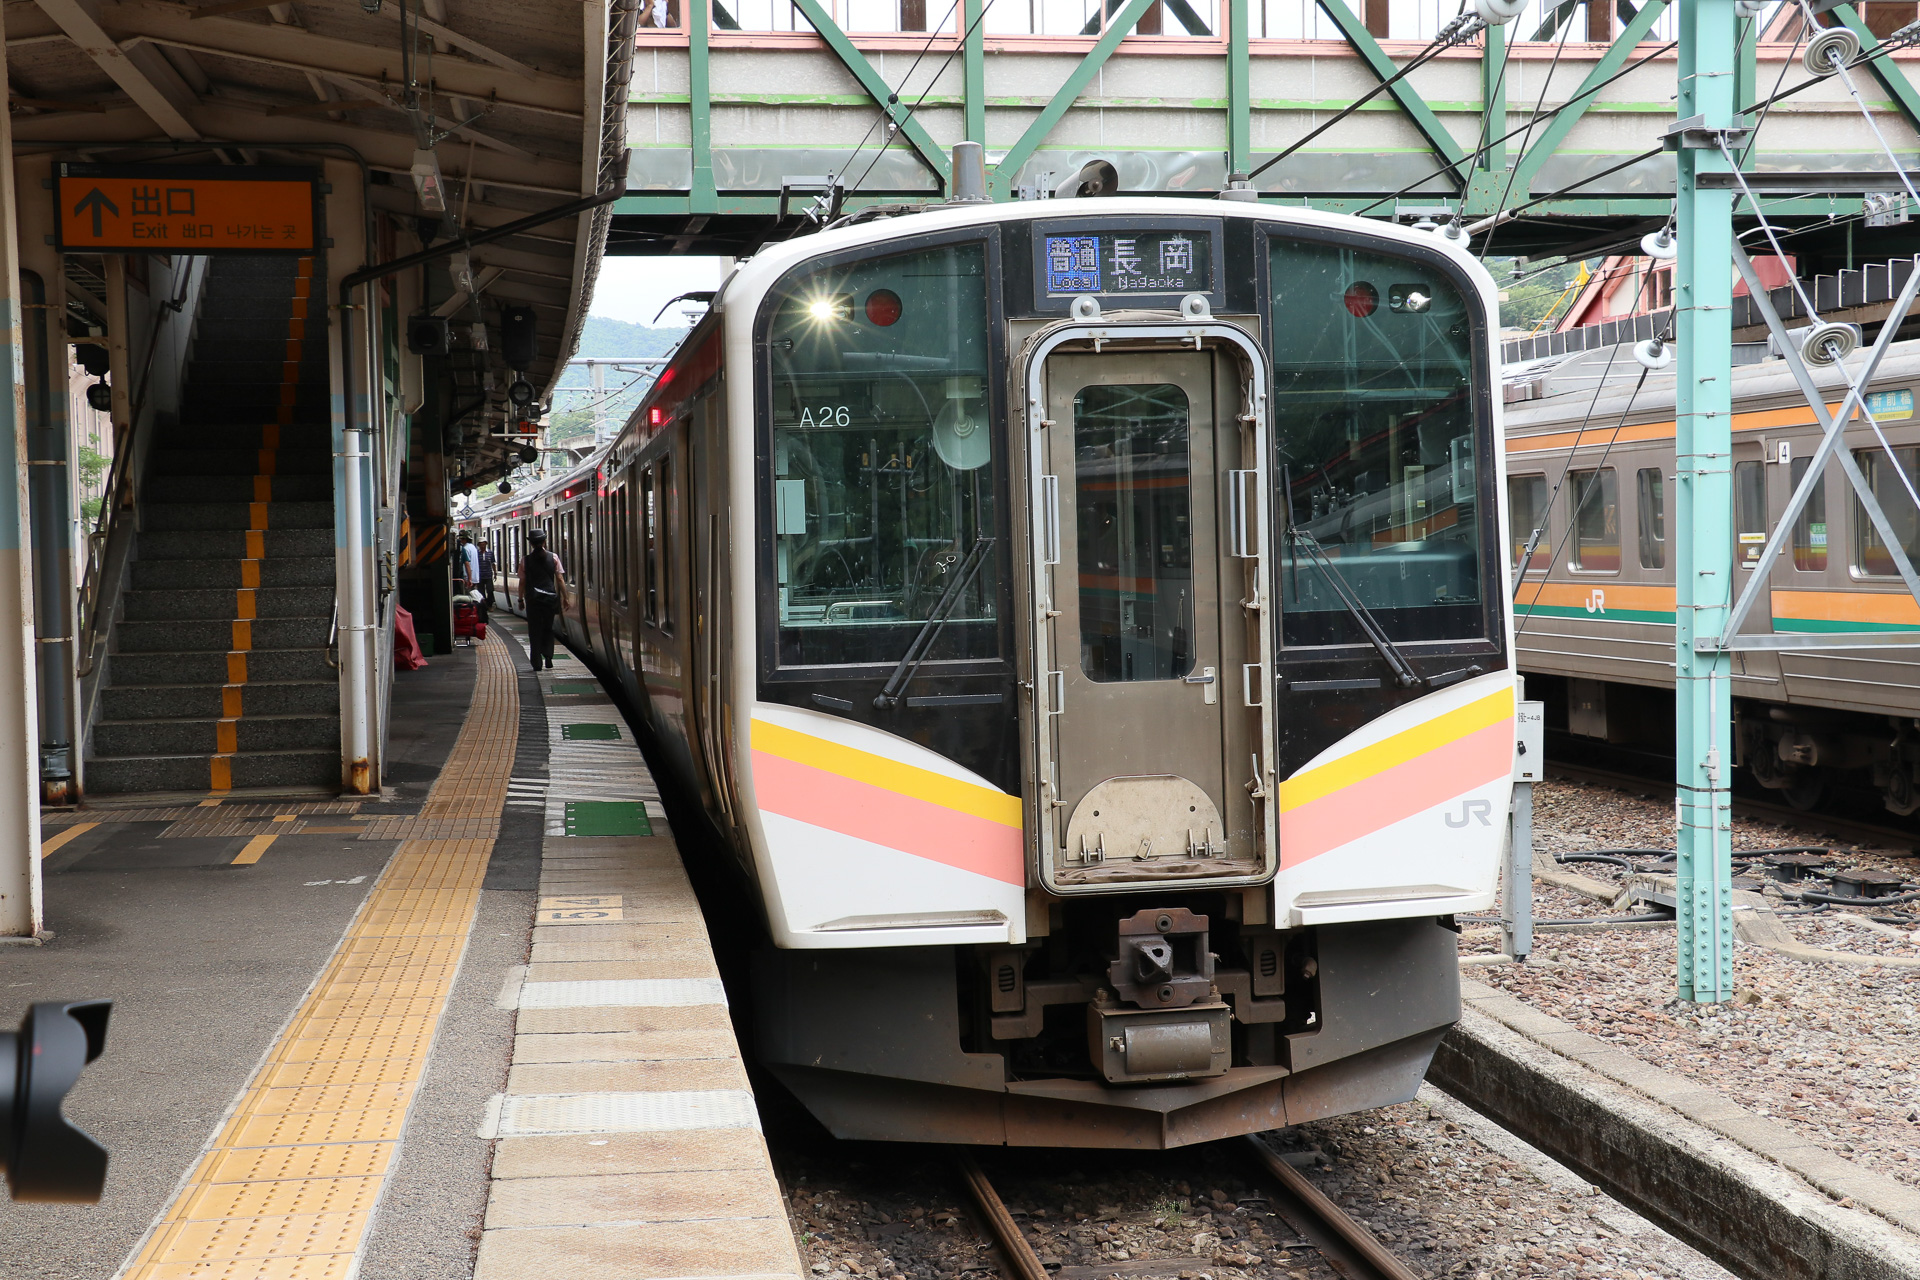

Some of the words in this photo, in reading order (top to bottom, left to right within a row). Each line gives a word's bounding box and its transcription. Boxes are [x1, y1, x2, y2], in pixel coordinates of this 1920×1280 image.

[132, 185, 195, 216] 出口
[132, 222, 168, 239] Exit
[183, 223, 214, 239] 出口
[227, 224, 274, 239] 나가는
[281, 224, 297, 240] 곳
[1049, 238, 1098, 272] 普通
[1108, 238, 1193, 275] 長岡
[1052, 274, 1099, 289] Local
[1118, 275, 1184, 289] Nagaoka
[800, 406, 850, 428] A26
[1781, 444, 1787, 460] 4
[1585, 589, 1606, 613] JR
[1445, 799, 1492, 829] JR
